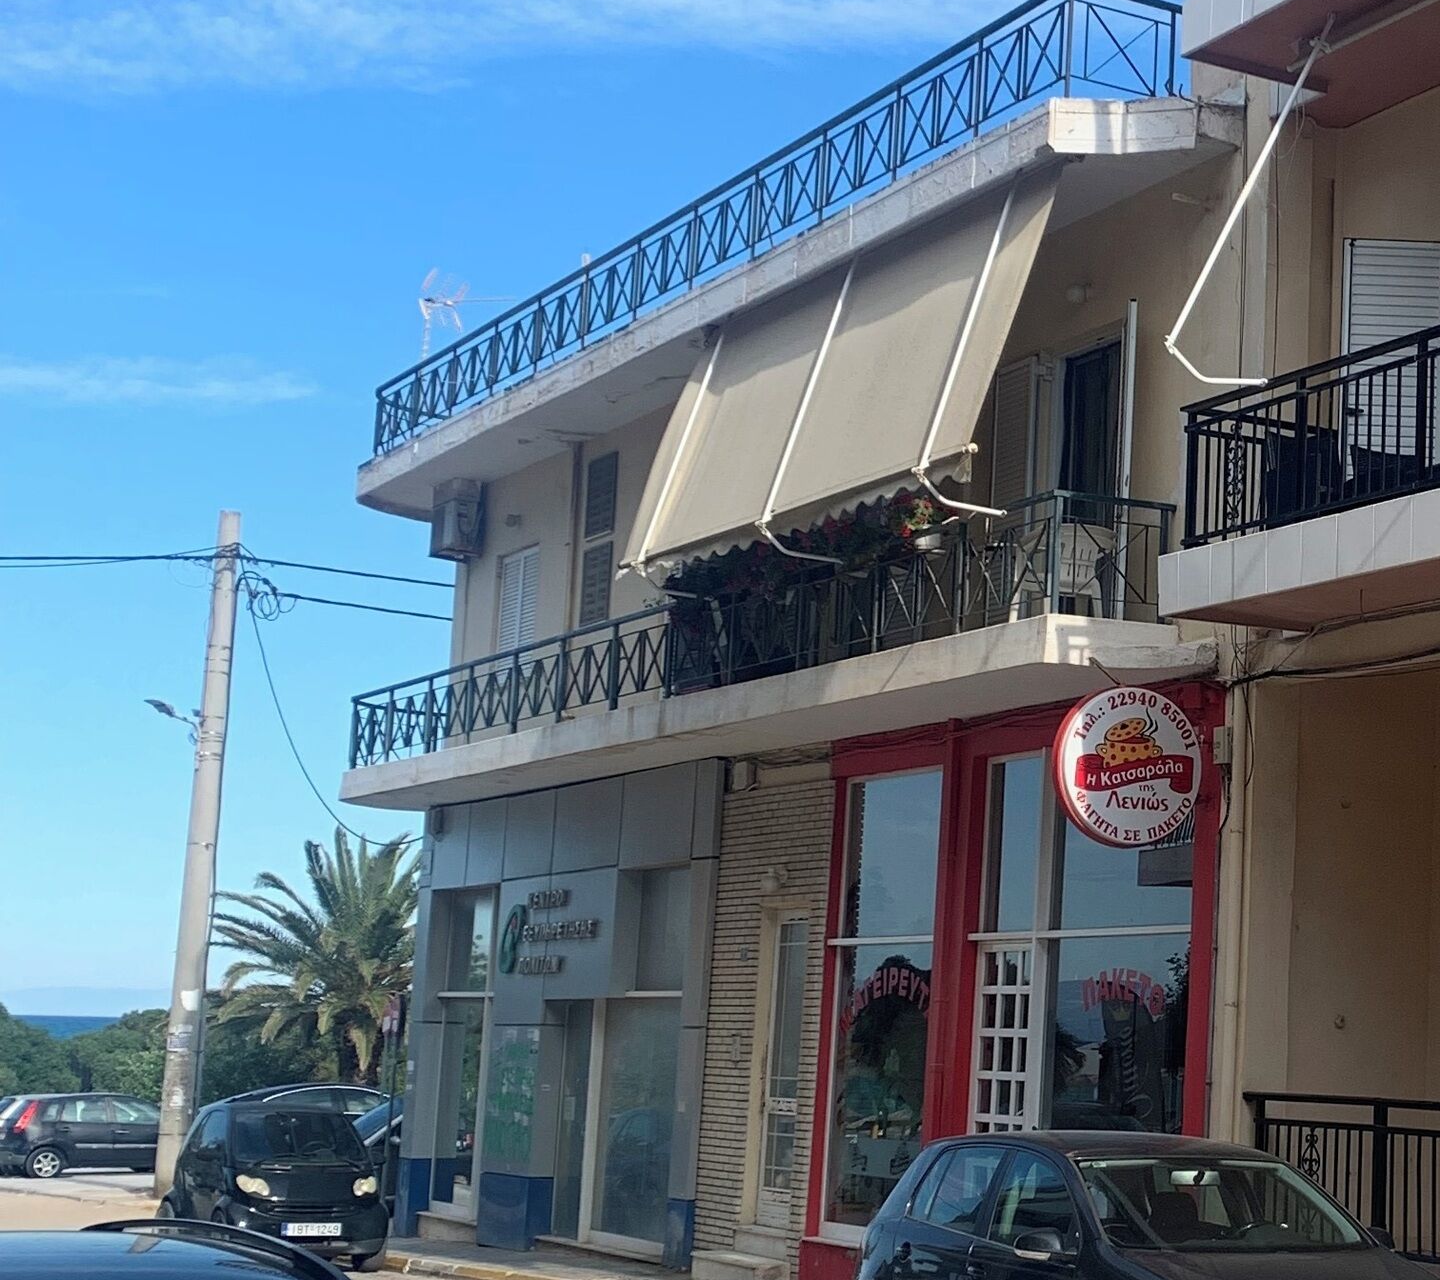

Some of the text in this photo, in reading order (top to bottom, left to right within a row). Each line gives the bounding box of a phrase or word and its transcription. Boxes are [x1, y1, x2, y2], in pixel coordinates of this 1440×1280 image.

[1074, 691, 1197, 751] Τηλ.: 22940 85001
[1100, 759, 1184, 786] Κατσαρόλα
[1138, 783, 1155, 793] της
[1076, 790, 1192, 842] ΦΑΓΗΤΑ ΣΕ ΠΑΚΕΤΟ
[1105, 791, 1169, 812] Λενιώς
[1080, 967, 1165, 1017] ΠΑΚΕΤΟ
